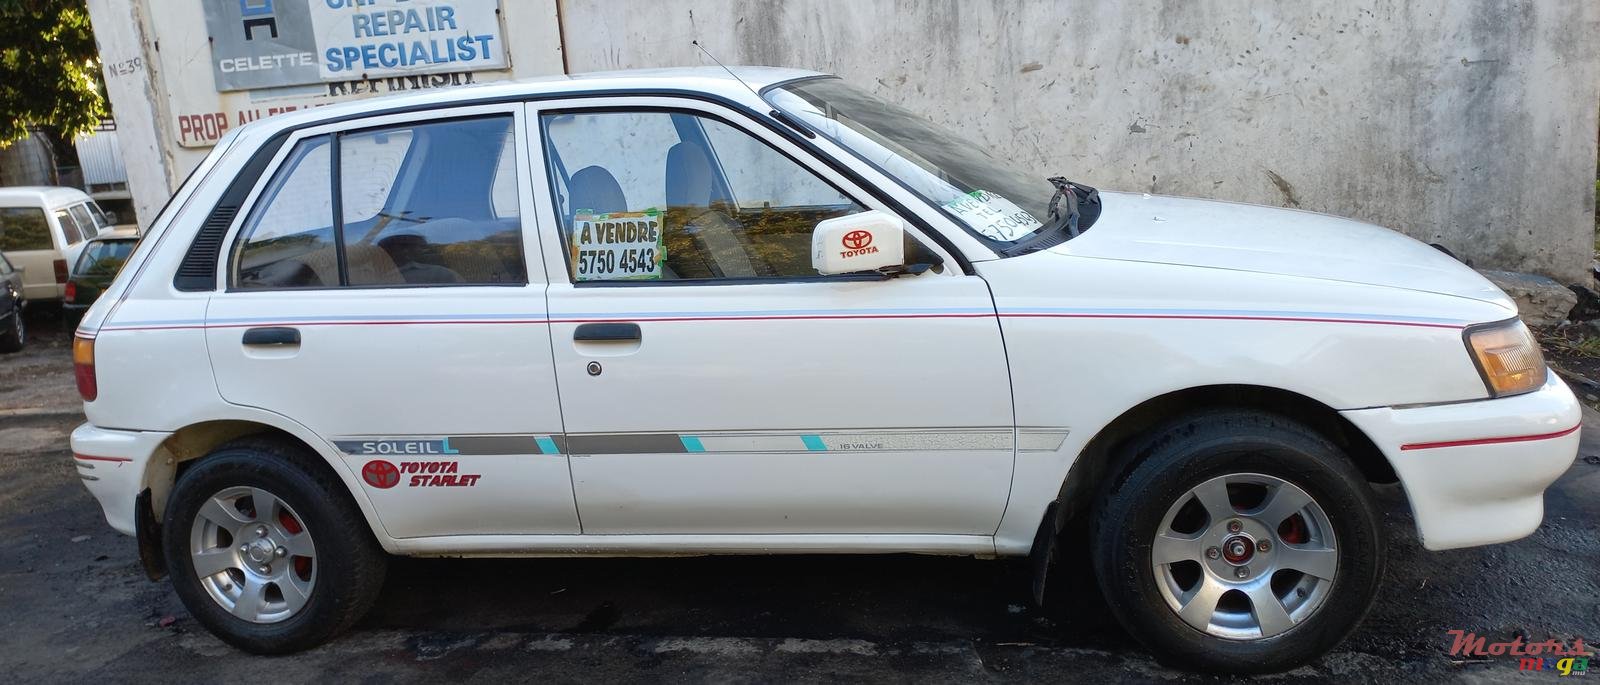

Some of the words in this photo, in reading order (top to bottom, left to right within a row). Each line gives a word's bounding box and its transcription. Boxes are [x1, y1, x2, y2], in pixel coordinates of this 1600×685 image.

[352, 6, 457, 38] REPAIR
[220, 52, 313, 73] CELETTE
[325, 34, 494, 72] SPECIALIST
[580, 222, 592, 244] A
[595, 221, 658, 244] VENDRE
[579, 250, 615, 274] 5750
[619, 248, 655, 273] 4543
[840, 246, 879, 258] TOYOTA
[362, 442, 439, 454] SOLEIL
[400, 462, 458, 474] TOYOTA
[409, 475, 481, 487] STARLET
